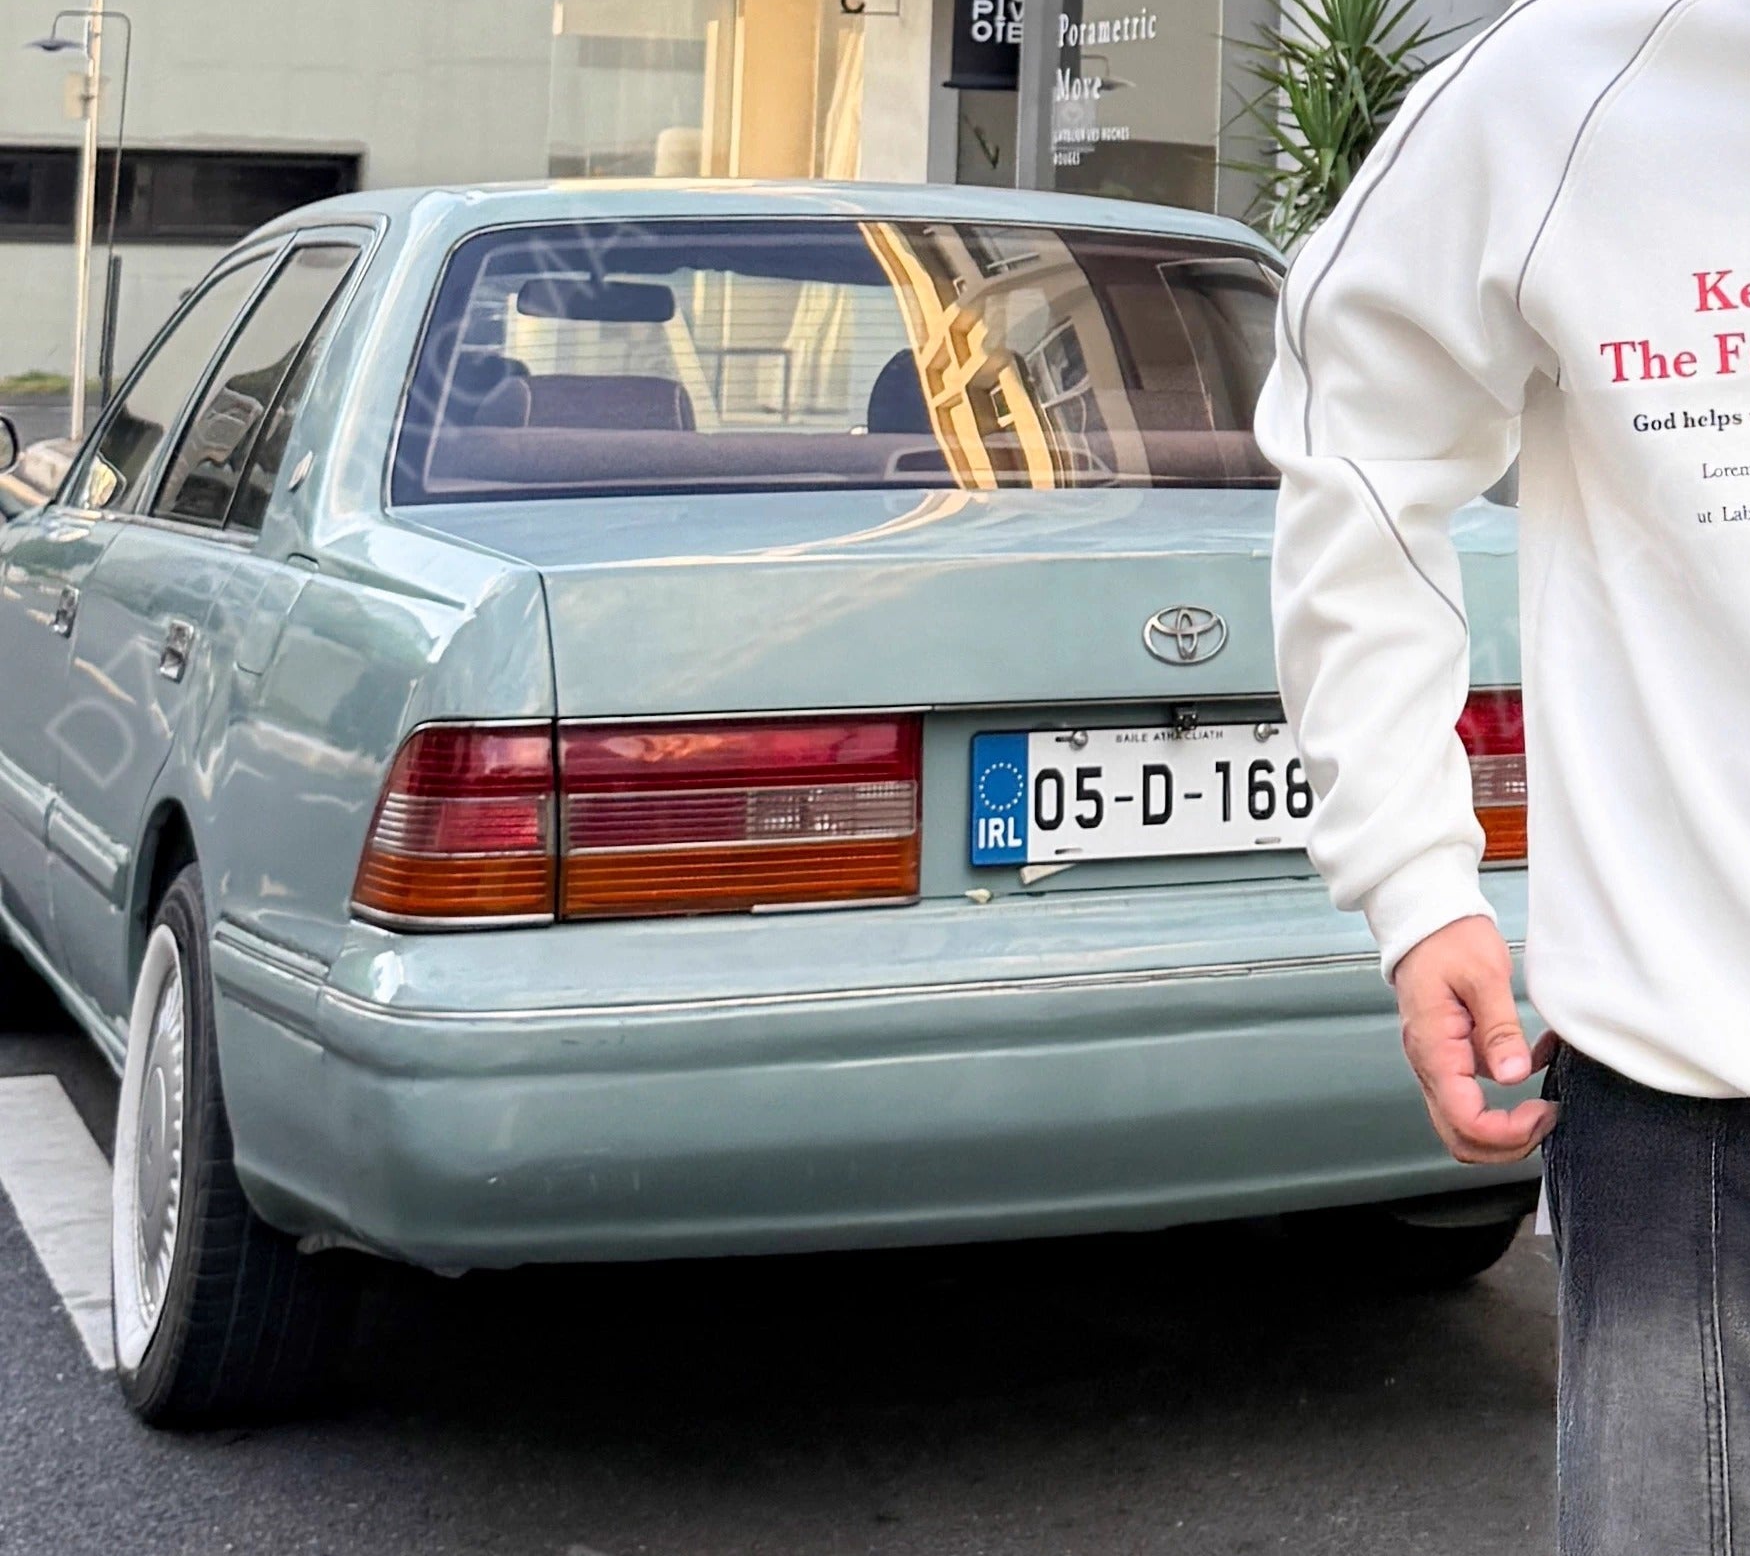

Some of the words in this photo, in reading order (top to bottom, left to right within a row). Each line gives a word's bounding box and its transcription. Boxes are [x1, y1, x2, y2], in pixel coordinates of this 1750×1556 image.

[1600, 339, 1698, 384] The
[1632, 411, 1677, 434] God
[1682, 407, 1743, 430] helps
[1696, 511, 1712, 524] ut
[1034, 757, 1315, 831] 05-D-168
[977, 817, 1023, 849] IRL
